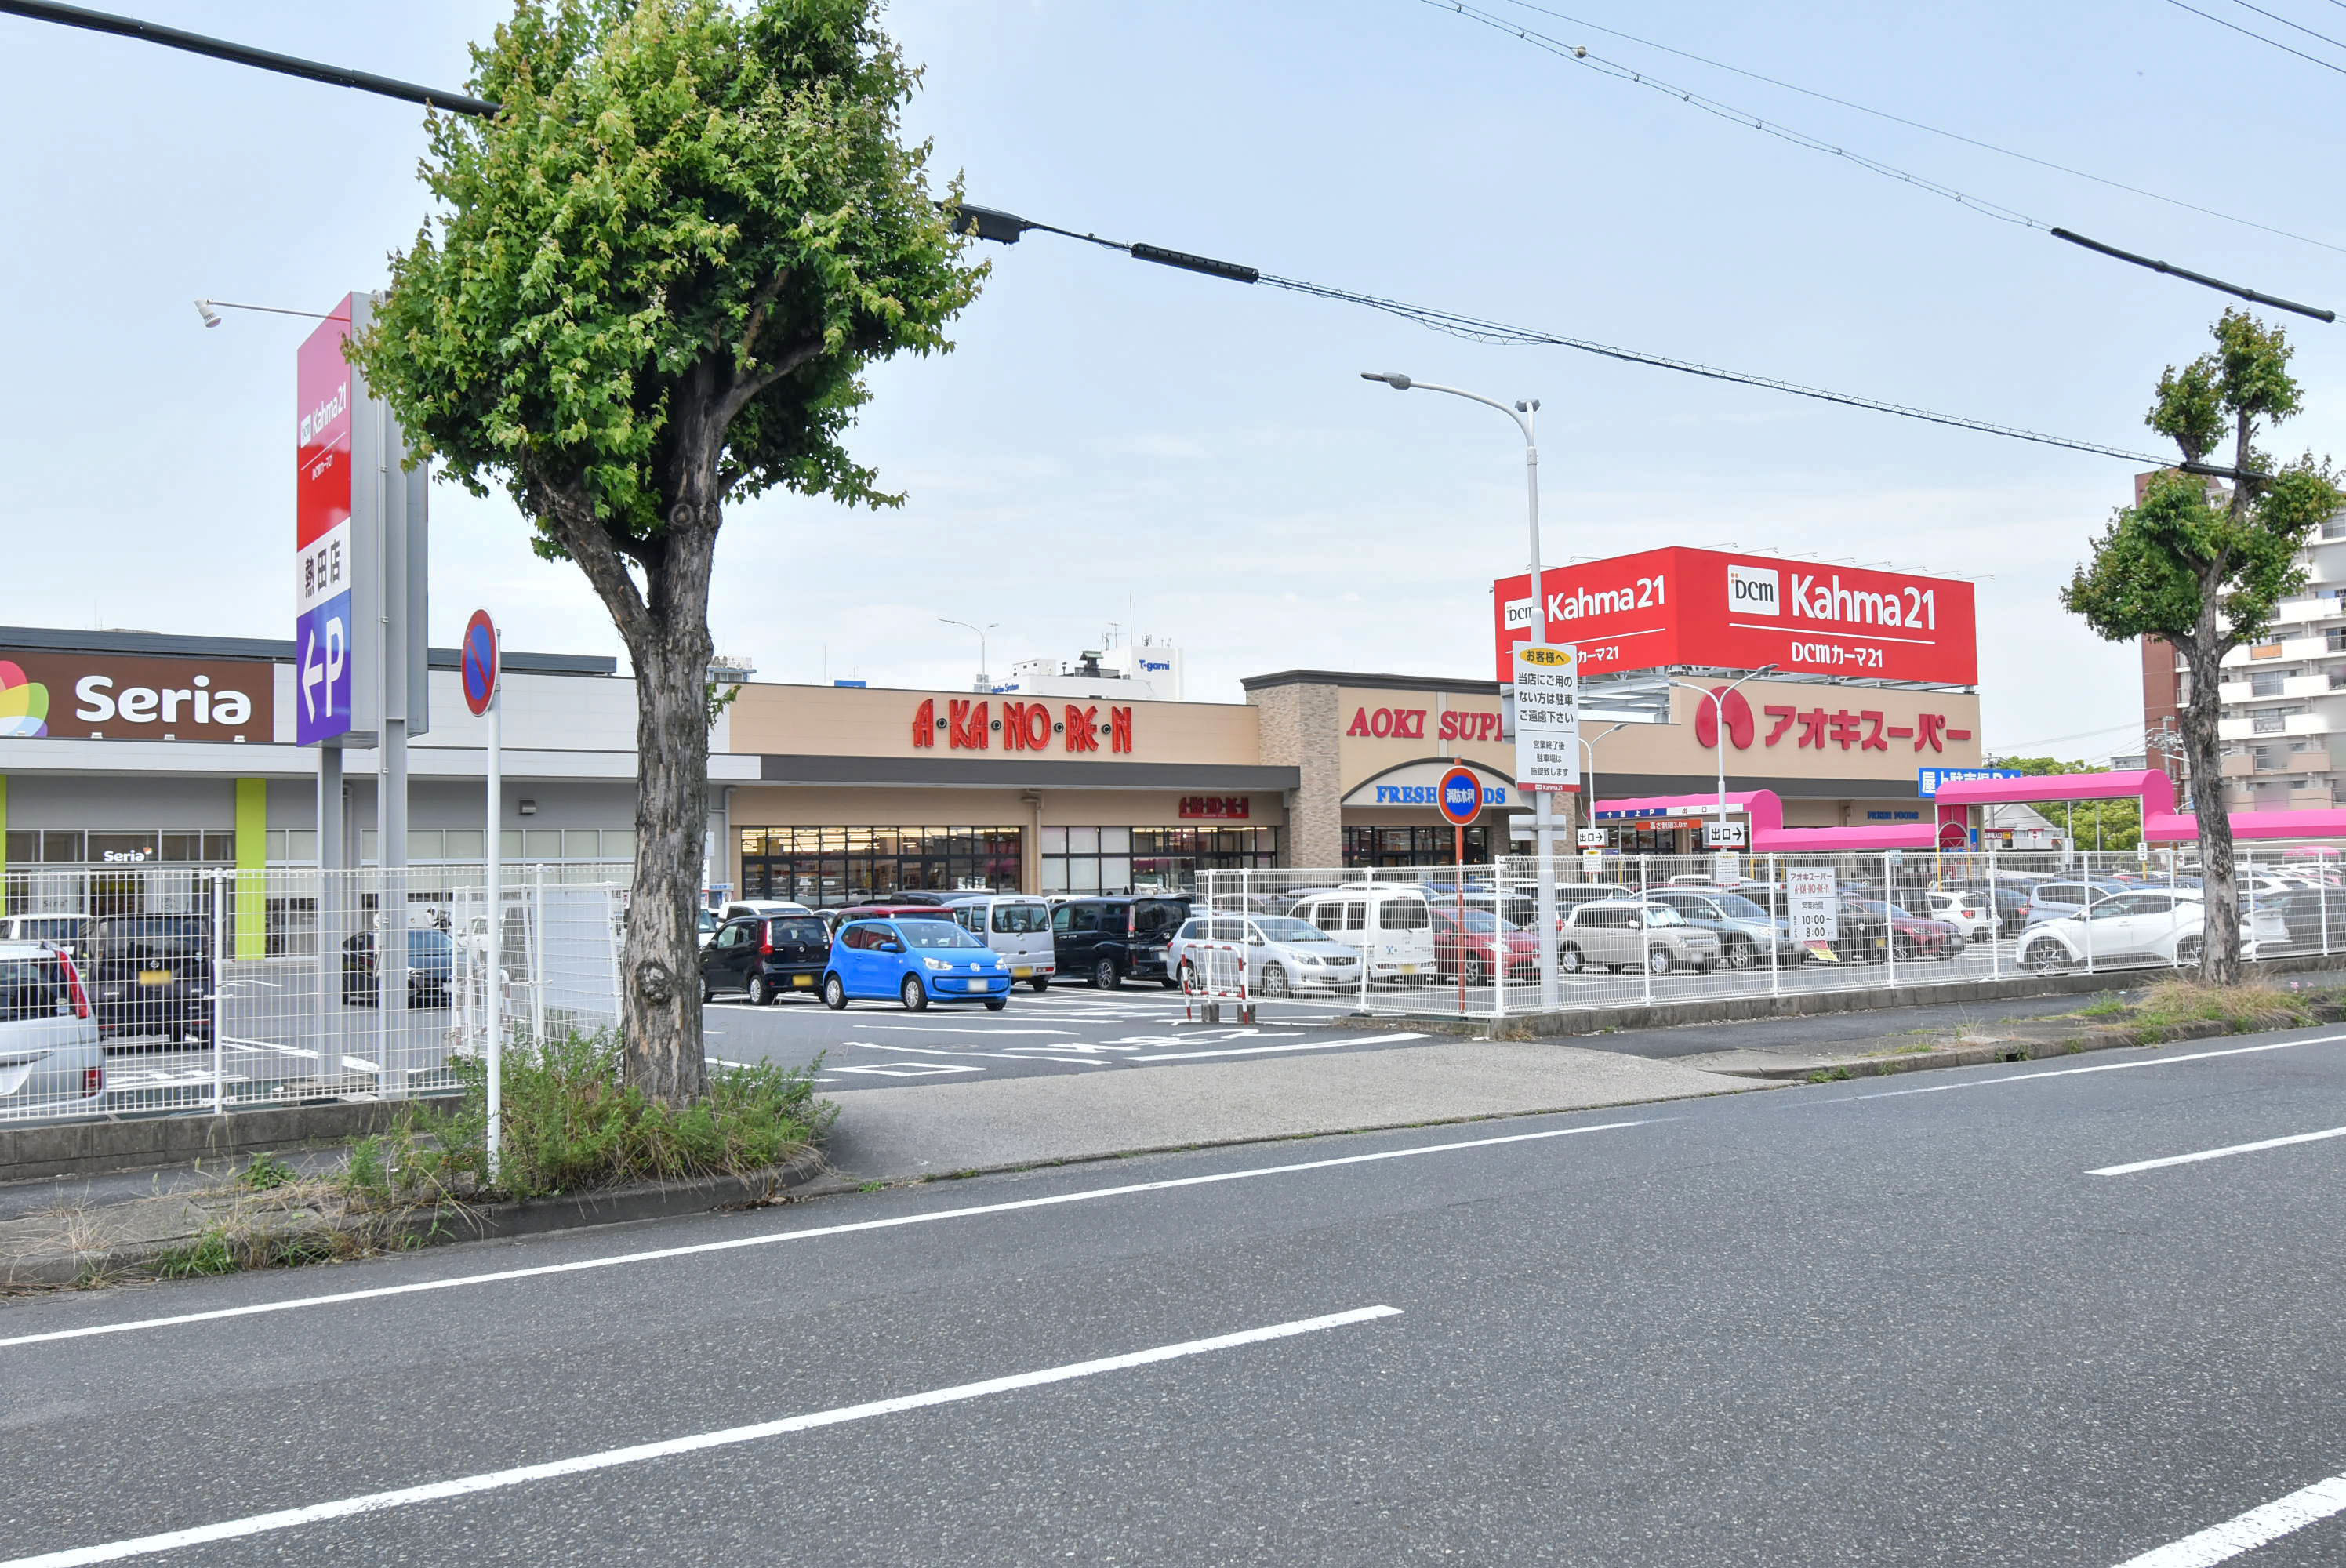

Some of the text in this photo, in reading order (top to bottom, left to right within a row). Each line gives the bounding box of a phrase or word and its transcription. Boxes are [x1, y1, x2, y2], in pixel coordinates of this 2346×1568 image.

[313, 381, 347, 437] Kahma21
[305, 539, 340, 600] 熱田店
[1547, 575, 1665, 623] Kahma21
[1791, 573, 1935, 630] Kahma21
[1526, 651, 1565, 664] お客様へ
[1577, 645, 1619, 665] カーマ21
[326, 616, 345, 718] P
[1518, 672, 1573, 688] 当店にご用の
[75, 675, 251, 725] Seria
[1519, 691, 1574, 706] ない方は駐車
[1346, 707, 1502, 742] AOKI SUP
[1520, 710, 1574, 724] ご遠慮下さい
[1764, 705, 1972, 753] アオキスーパー
[1533, 740, 1565, 750] 営業終了後
[1536, 753, 1563, 764] 駐車場は
[1376, 786, 1439, 804] FRESH
[1580, 832, 1594, 842] 出口
[1711, 827, 1731, 841] 出口
[104, 849, 145, 862] Seria
